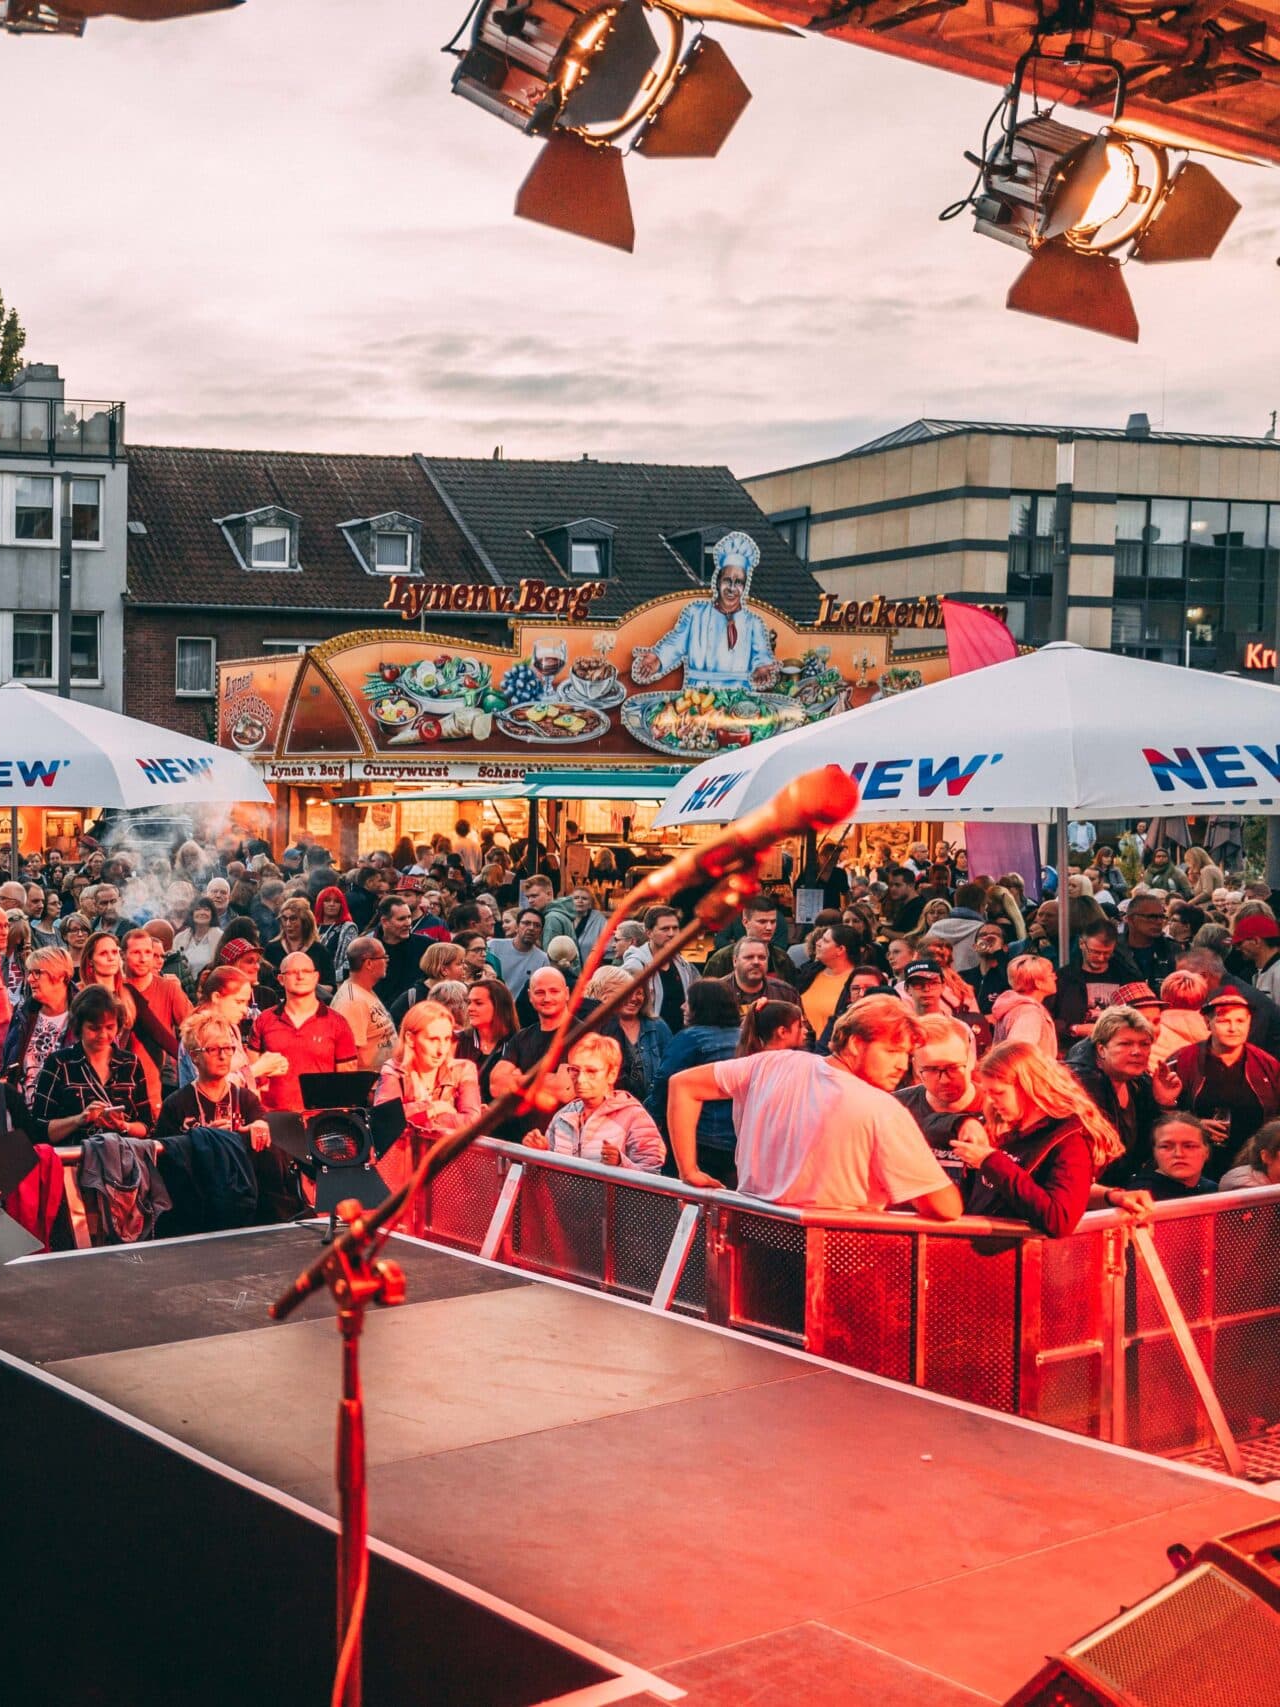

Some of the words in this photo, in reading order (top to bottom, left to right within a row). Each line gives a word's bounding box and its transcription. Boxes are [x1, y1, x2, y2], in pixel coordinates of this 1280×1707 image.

[384, 576, 488, 620] Lynen
[489, 585, 516, 612] v.
[270, 766, 304, 778] Lynen
[308, 767, 316, 776] v.
[319, 765, 345, 778] Berg
[363, 764, 449, 778] Currywurst
